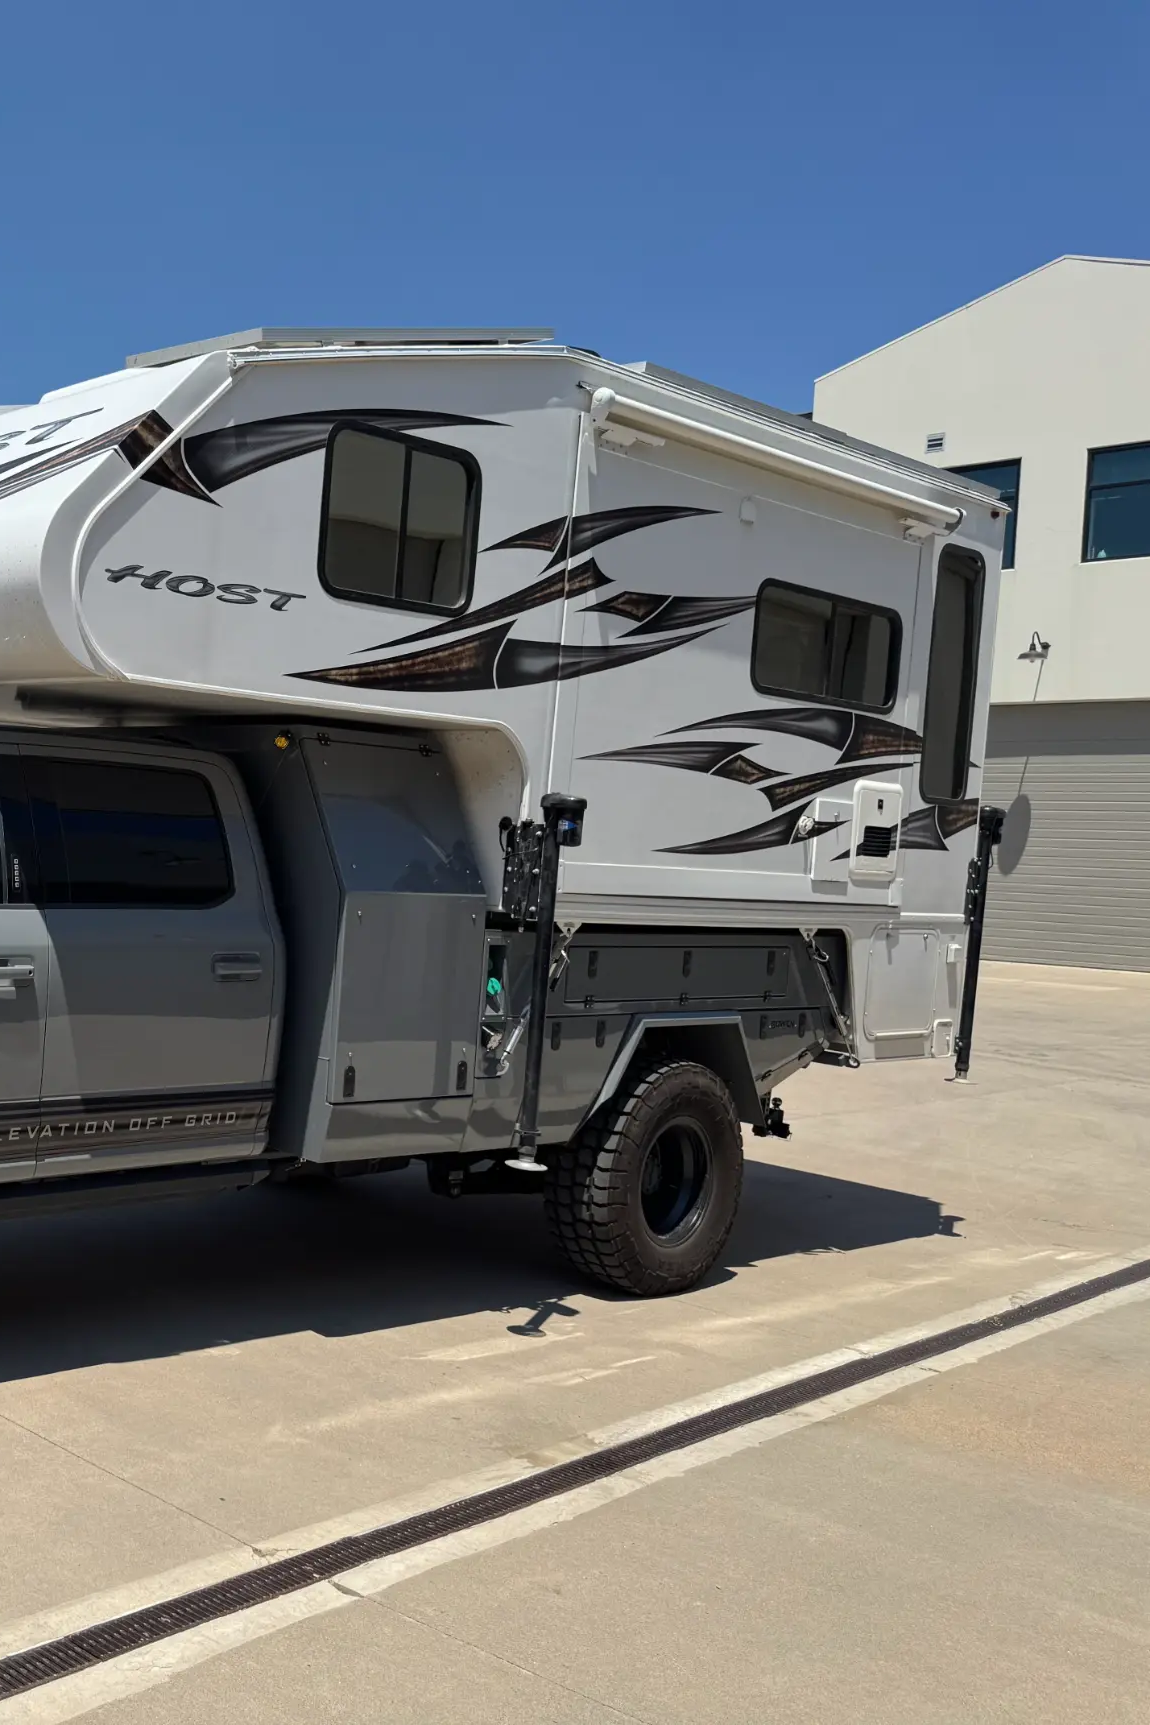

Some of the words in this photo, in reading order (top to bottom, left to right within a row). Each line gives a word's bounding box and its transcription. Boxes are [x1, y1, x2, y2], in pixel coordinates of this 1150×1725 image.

[104, 564, 307, 612] HOST
[129, 1115, 173, 1131] OFF
[184, 1111, 237, 1128] GRID
